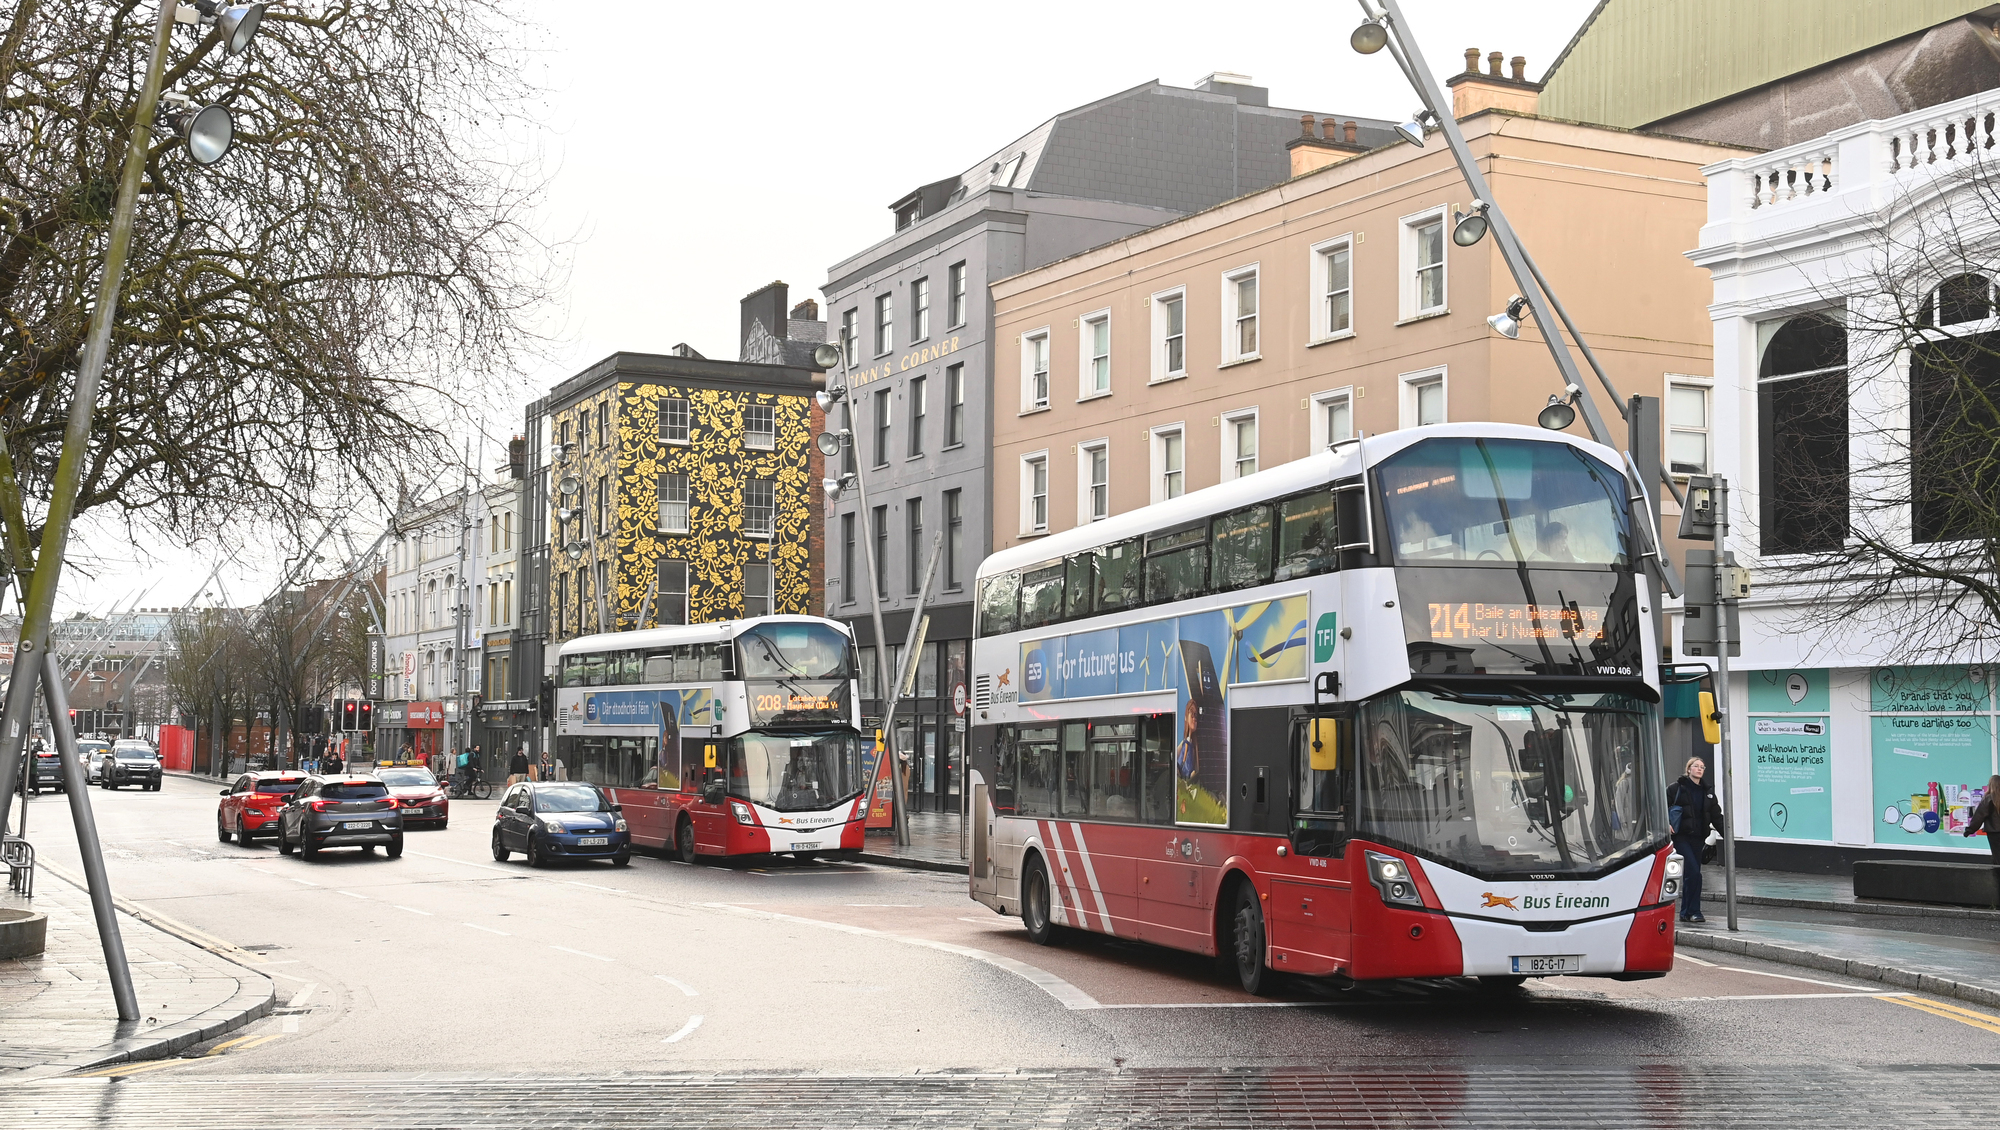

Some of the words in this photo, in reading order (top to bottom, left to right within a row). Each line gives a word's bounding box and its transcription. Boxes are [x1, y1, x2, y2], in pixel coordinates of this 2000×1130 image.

[901, 336, 960, 371] CORNER
[1475, 603, 1505, 620] Baile
[1509, 609, 1522, 619] an
[1525, 604, 1577, 620] Ghleanna
[1580, 608, 1598, 621] via
[1428, 603, 1470, 638] 214
[1472, 623, 1492, 637] har
[1317, 628, 1333, 647] TFI
[1056, 651, 1077, 681] For
[1078, 649, 1116, 678] future
[1119, 650, 1135, 674] us
[1596, 666, 1616, 675] VWD
[1618, 667, 1632, 675] 406
[757, 694, 782, 711] 208
[990, 691, 1000, 705] Bus
[1900, 691, 1931, 701] Brands
[1932, 691, 1953, 700] that
[1955, 692, 1972, 702] you
[1891, 703, 1925, 712] already
[1927, 703, 1946, 712] love
[1956, 703, 1972, 711] and
[1892, 718, 1920, 728] future
[1921, 718, 1954, 729] darlings
[1956, 719, 1972, 727] too
[1756, 743, 1798, 753] Well-known
[1799, 743, 1826, 754] brands
[1757, 755, 1767, 763] at
[1768, 754, 1785, 764] fixed
[1786, 754, 1799, 764] low
[1801, 755, 1824, 766] prices
[1523, 895, 1551, 909] Bus
[1555, 892, 1610, 909] Éireann
[1530, 958, 1566, 970] 182-G-17
